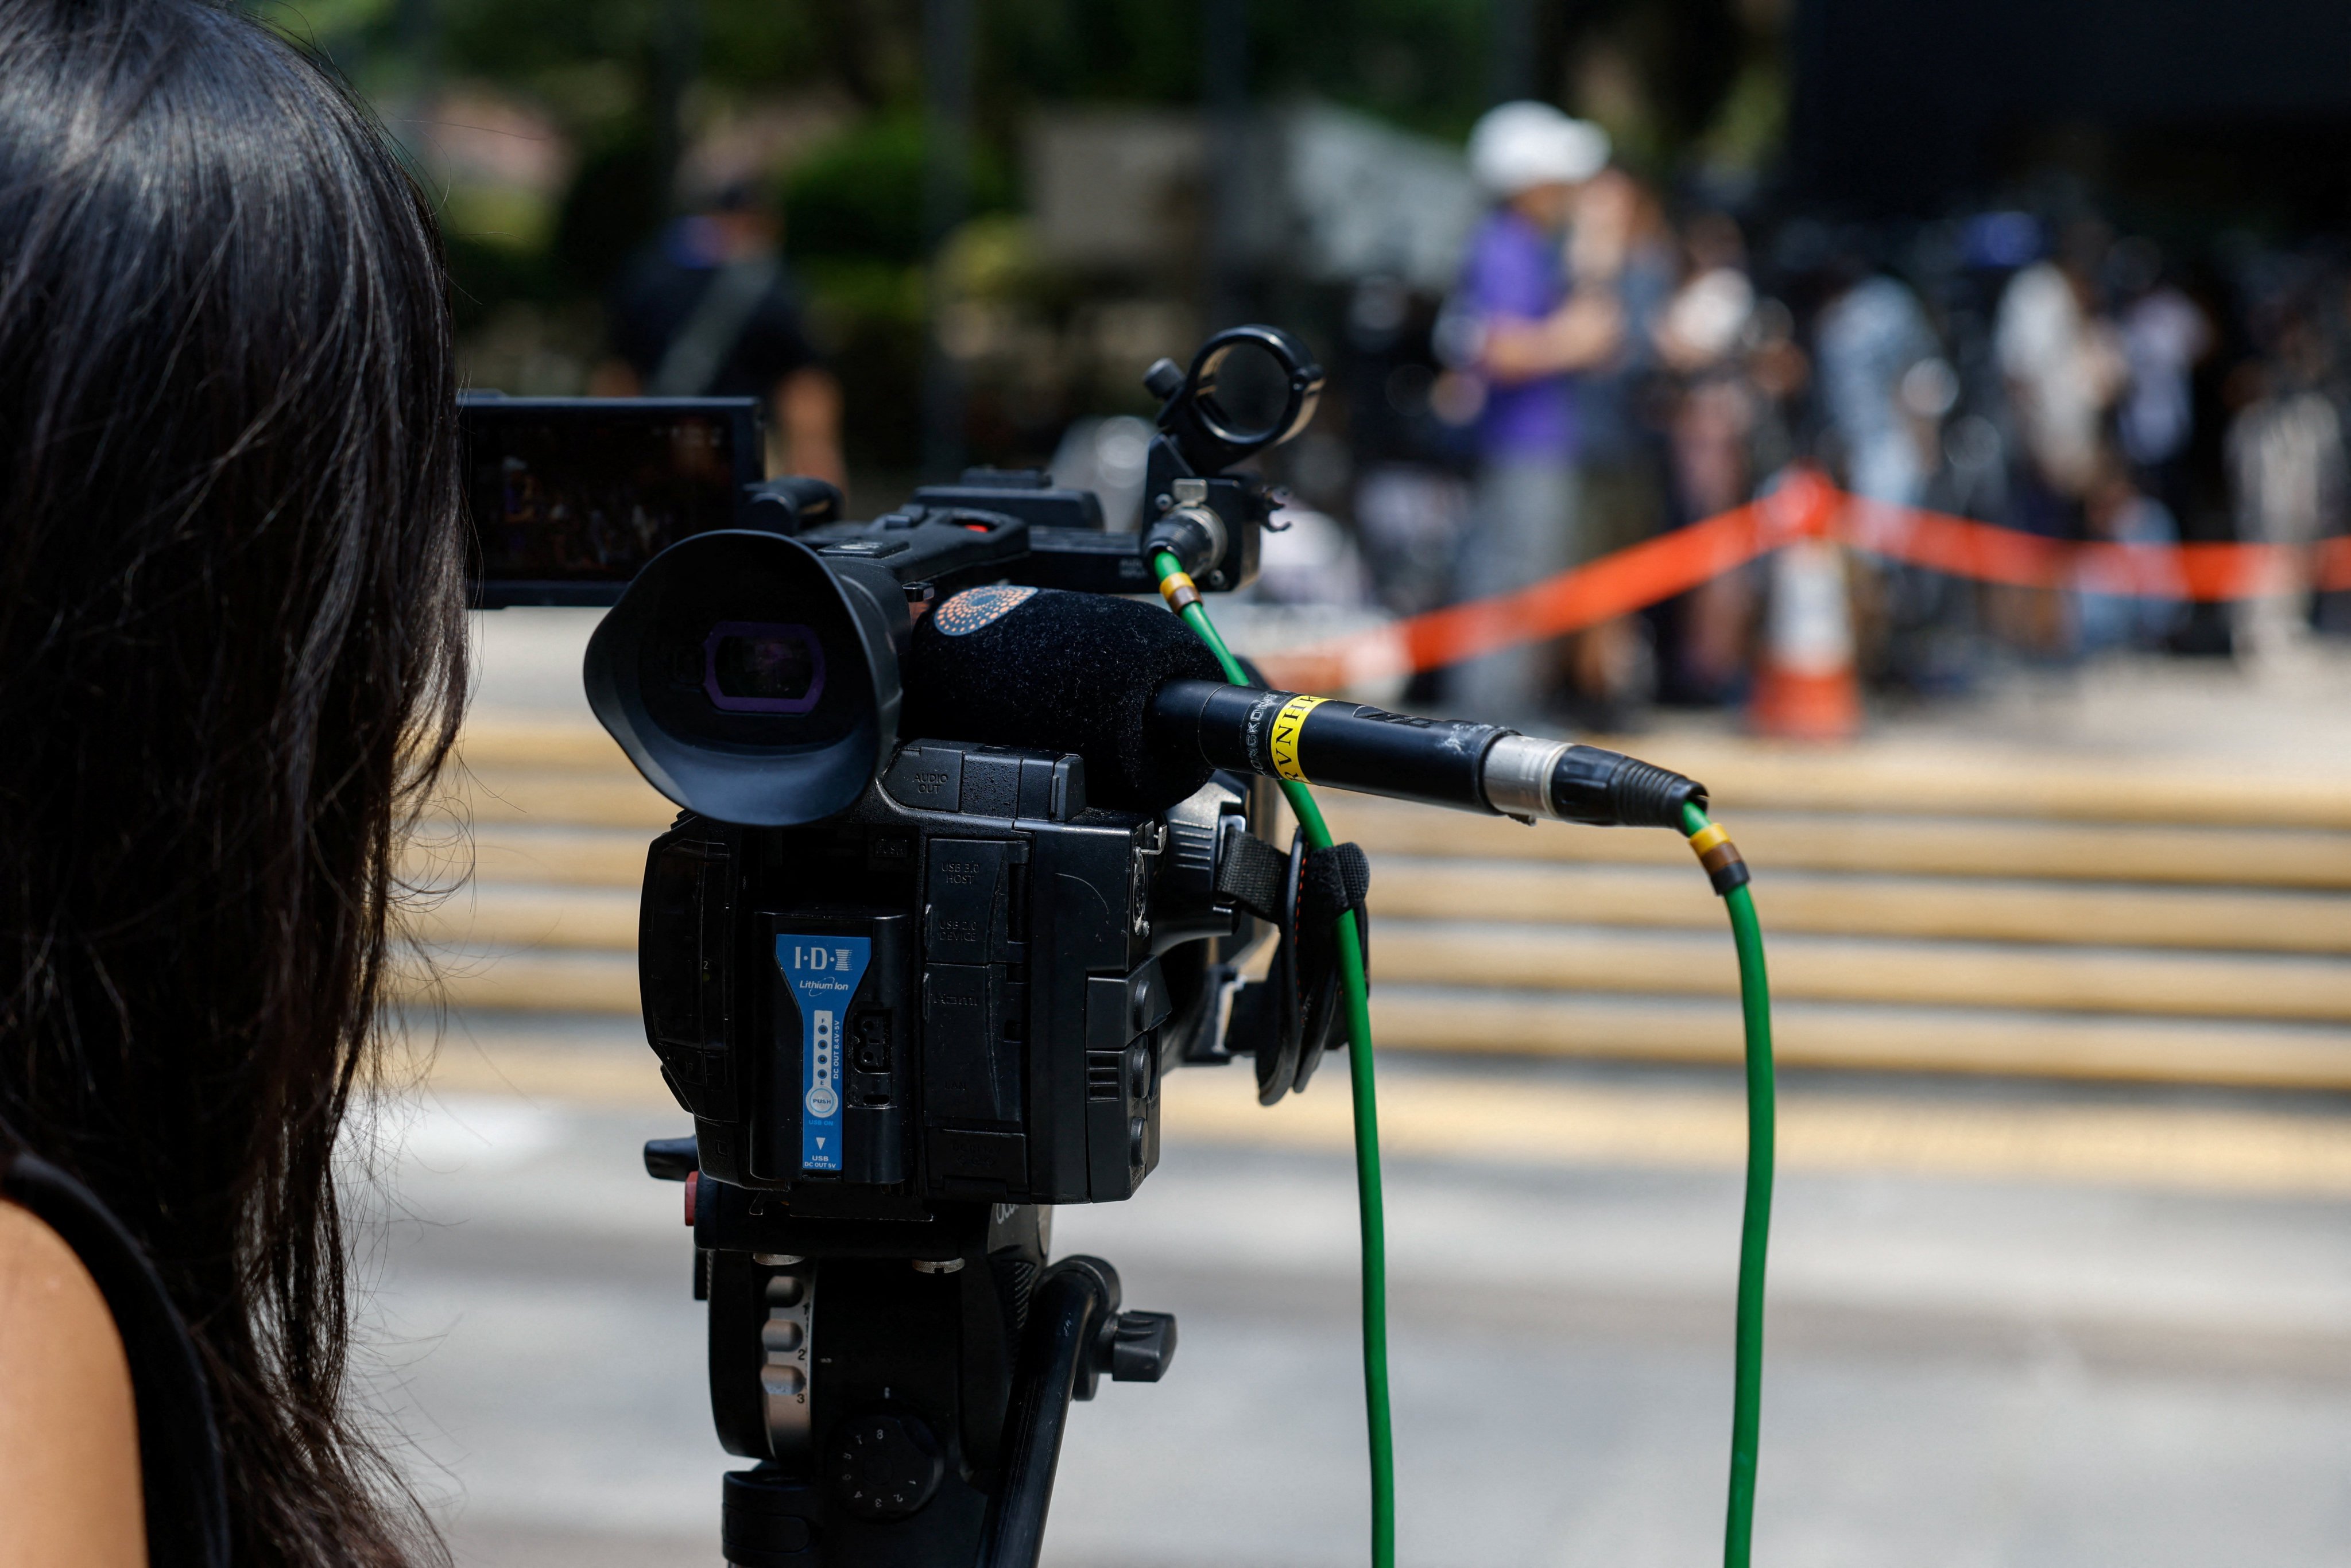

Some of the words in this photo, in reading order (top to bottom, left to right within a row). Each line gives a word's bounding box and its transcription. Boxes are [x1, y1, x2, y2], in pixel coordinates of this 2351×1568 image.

[915, 773, 948, 783] AUDIO
[919, 783, 941, 794] OUT
[942, 863, 960, 872] USB
[964, 864, 979, 873] 3.0
[946, 875, 974, 884] HOST
[939, 920, 958, 930] USB
[962, 921, 977, 930] 2.0
[939, 932, 977, 942] DEVICE
[703, 961, 708, 969] 2
[799, 980, 832, 990] Lithium
[834, 982, 849, 991] Ion
[833, 1069, 839, 1079] DC
[945, 1081, 966, 1091] LAN
[798, 1349, 806, 1360] 2
[797, 1394, 805, 1404] 3
[876, 1429, 884, 1440] 8
[874, 1497, 882, 1508] 3
[893, 1493, 904, 1503] 2
